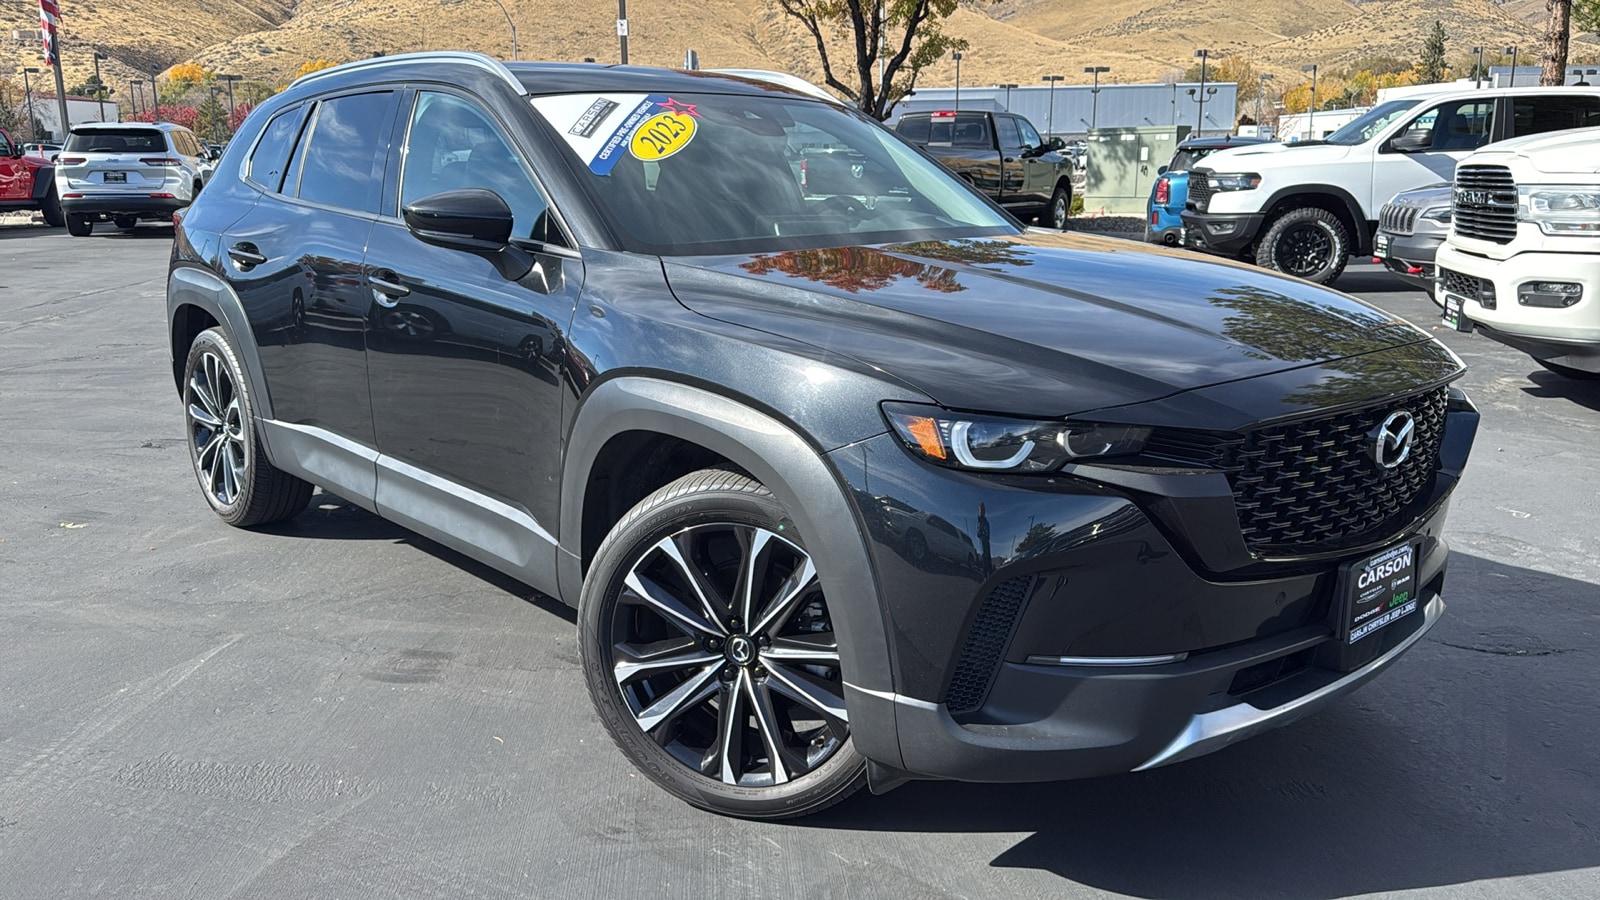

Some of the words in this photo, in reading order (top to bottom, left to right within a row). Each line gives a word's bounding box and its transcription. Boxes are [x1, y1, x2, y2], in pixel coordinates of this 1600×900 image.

[572, 100, 609, 133] CARSON
[599, 136, 622, 159] CERTIFIED
[617, 113, 641, 137] PRE-OWNED
[635, 100, 654, 115] VEHICLE
[640, 115, 687, 155] 2023
[1460, 190, 1486, 204] RAM
[1358, 552, 1412, 589] CARSON
[1389, 591, 1409, 608] Jeep
